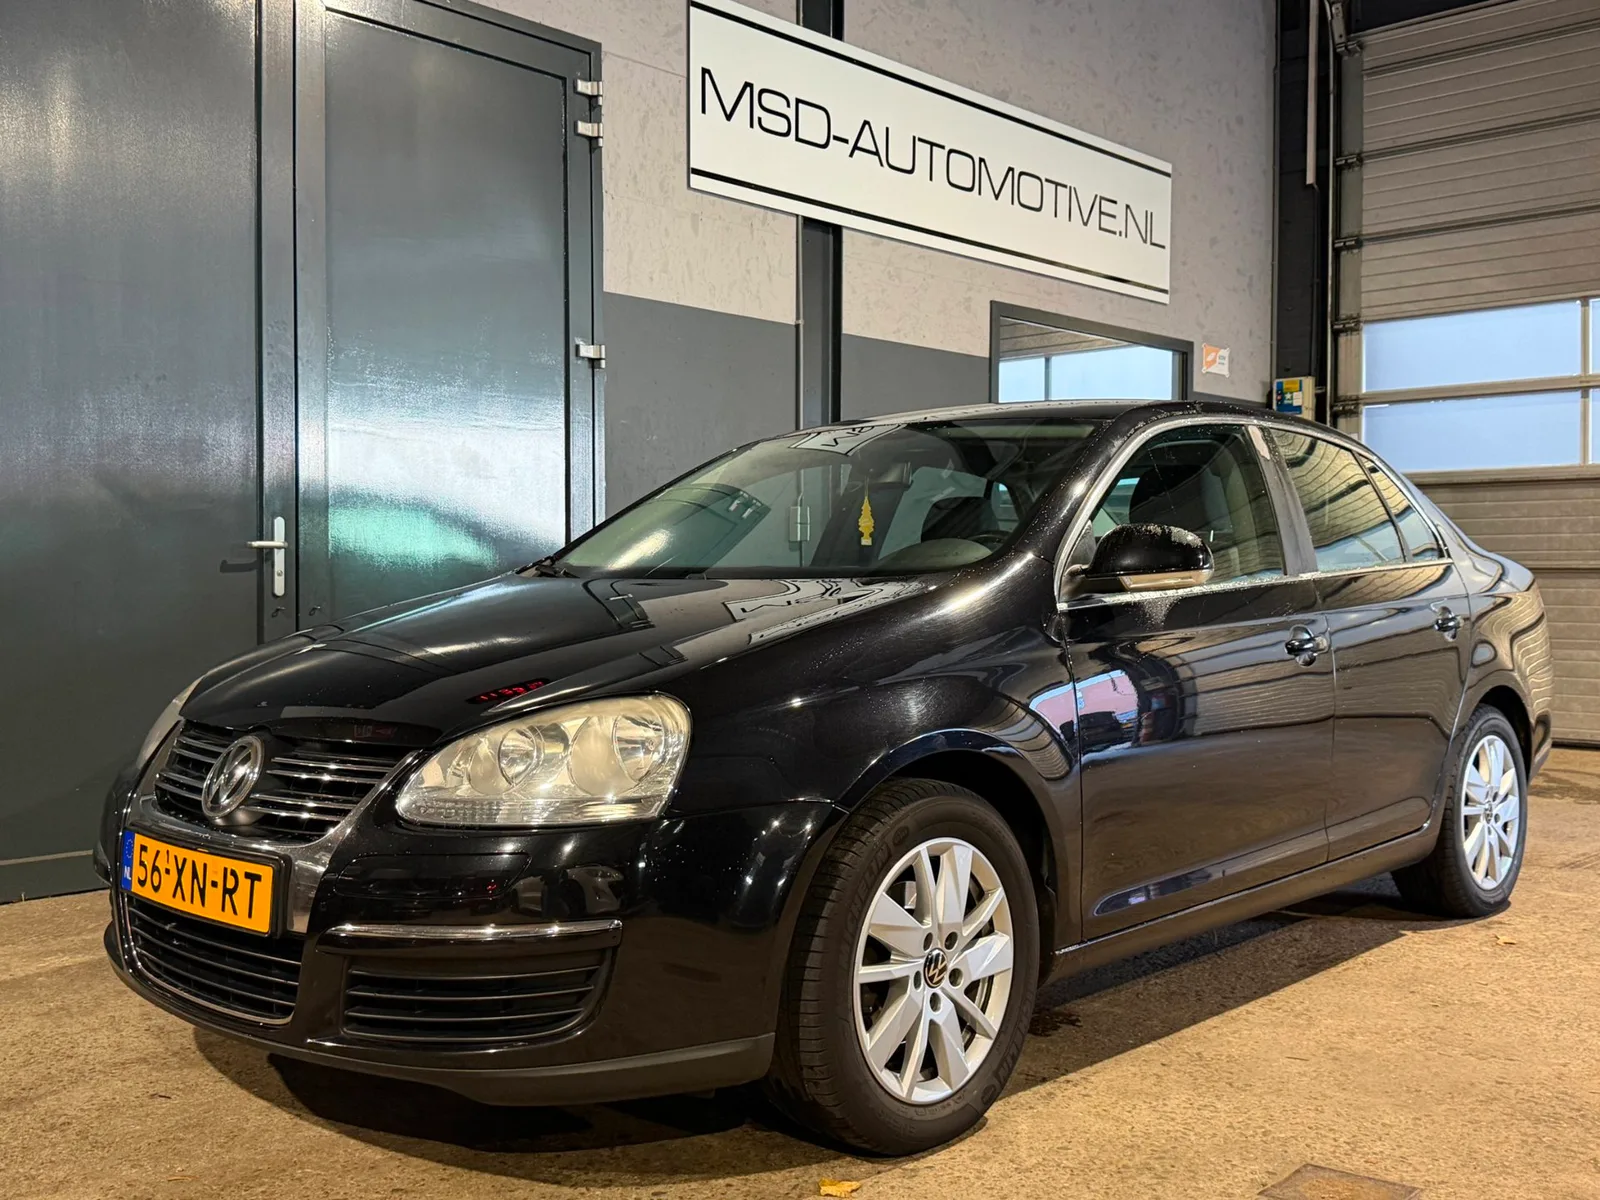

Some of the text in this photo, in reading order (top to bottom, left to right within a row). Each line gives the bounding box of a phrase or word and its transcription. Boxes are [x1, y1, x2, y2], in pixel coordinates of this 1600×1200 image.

[701, 66, 1166, 250] MSD-AUTOMOTIVE.NL
[124, 865, 132, 881] NL
[137, 844, 262, 919] 56-XN-RT
